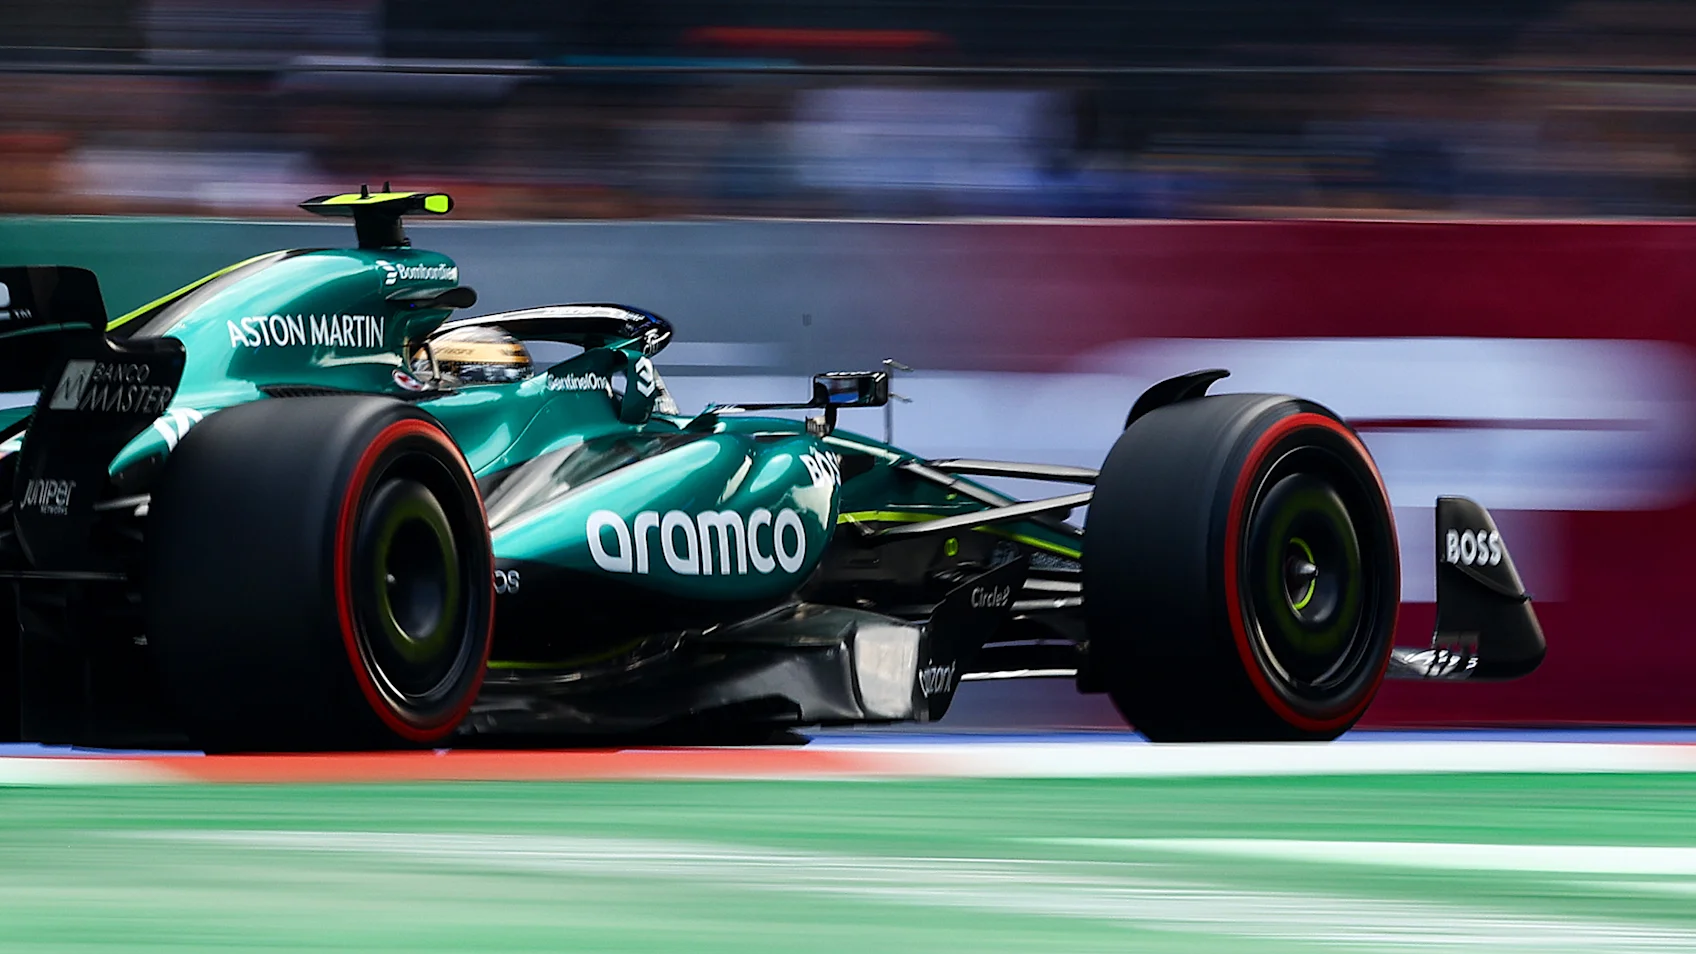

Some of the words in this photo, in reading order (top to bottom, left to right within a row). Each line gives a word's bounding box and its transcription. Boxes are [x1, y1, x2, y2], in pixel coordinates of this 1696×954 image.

[226, 313, 306, 348] ASTON
[309, 313, 384, 348] MARTIN
[92, 362, 150, 383] BANCO
[547, 371, 609, 391] SentinelOn
[79, 383, 172, 413] MASTER
[586, 507, 806, 576] aramco
[1446, 528, 1502, 566] BOSS
